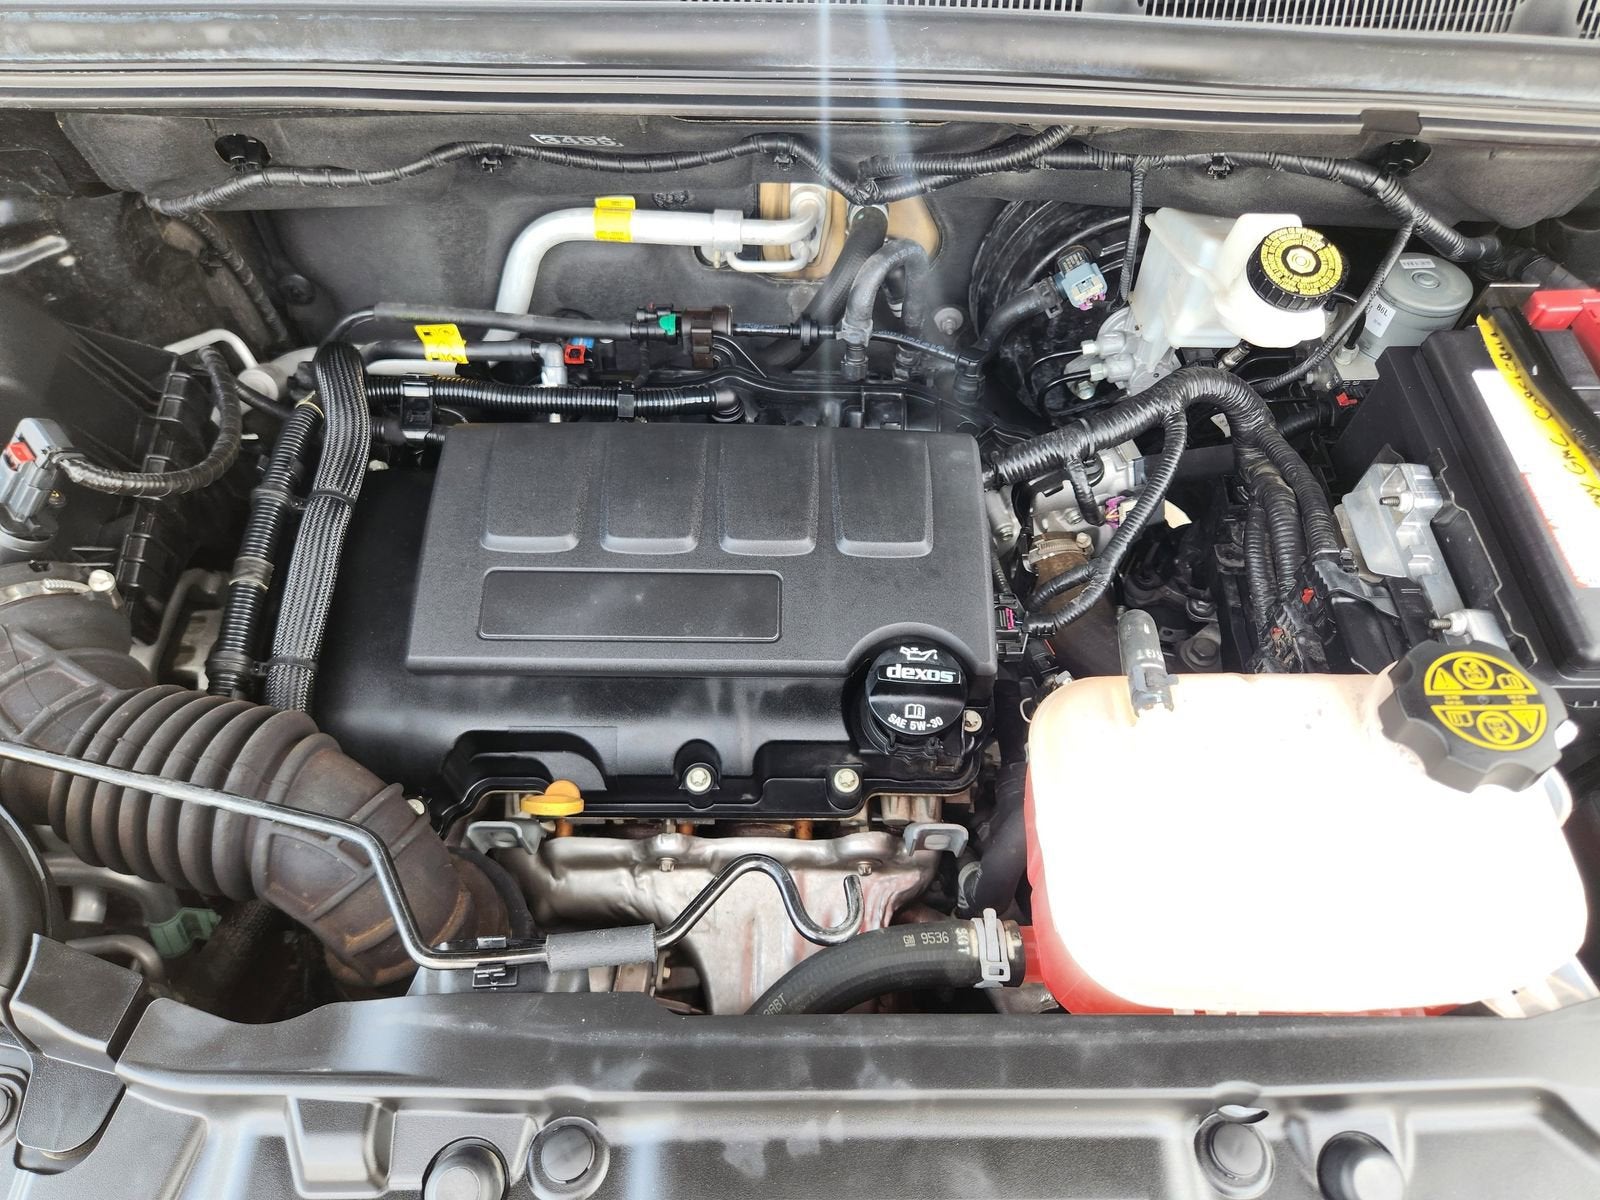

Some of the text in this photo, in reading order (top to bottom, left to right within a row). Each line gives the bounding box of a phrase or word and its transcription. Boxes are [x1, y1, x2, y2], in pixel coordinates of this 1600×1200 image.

[886, 663, 957, 683] dexos
[887, 713, 944, 731] SAE 5W-30
[903, 931, 950, 947] GM 9536
